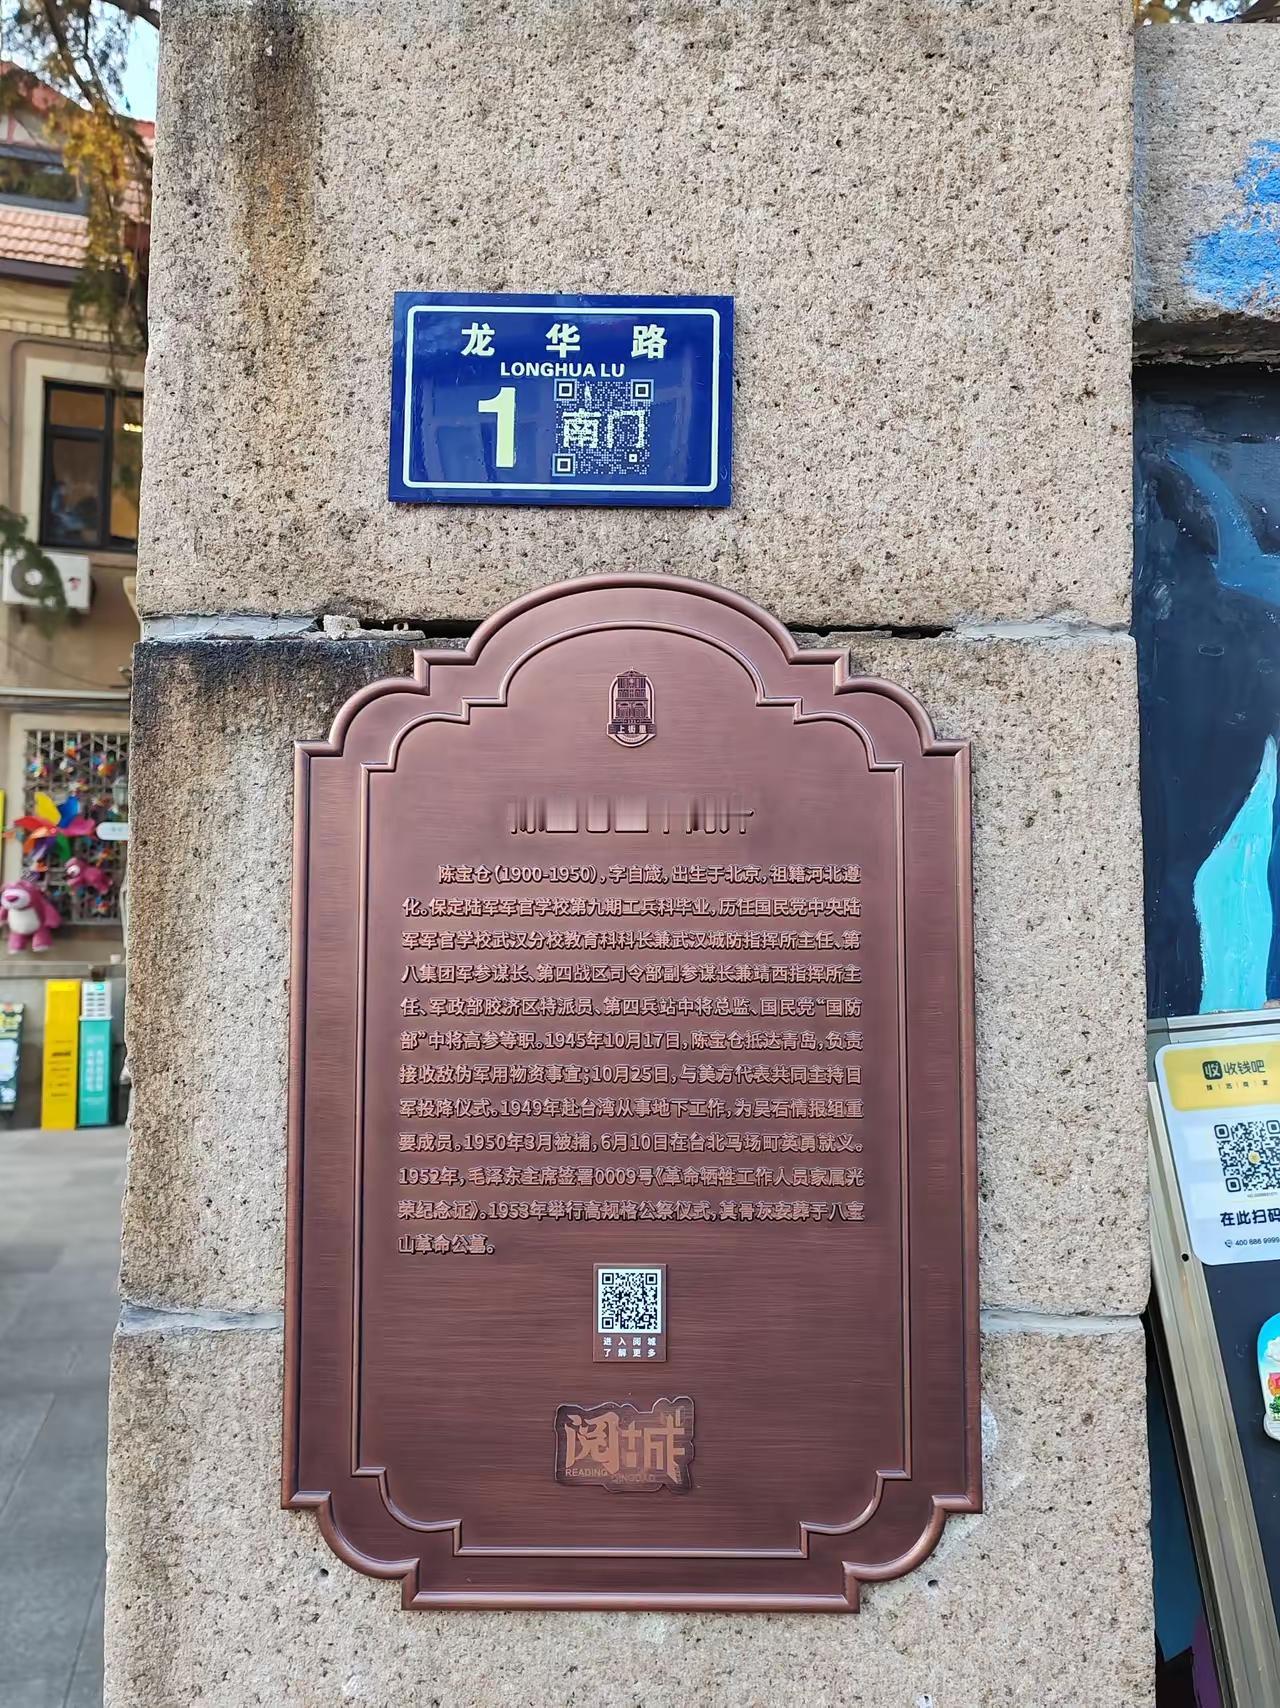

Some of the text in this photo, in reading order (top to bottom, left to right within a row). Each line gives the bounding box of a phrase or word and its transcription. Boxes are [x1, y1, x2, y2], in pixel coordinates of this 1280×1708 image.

[461, 322, 668, 359] 龙华路
[500, 362, 625, 377] LONGHUA LU
[478, 386, 516, 468] 1
[562, 408, 646, 449] 南门
[1224, 1060, 1266, 1075] 收钱吧
[1220, 1208, 1280, 1227] 在此扫码
[398, 1234, 495, 1254] 山革命公墓。
[565, 1468, 608, 1478] READING
